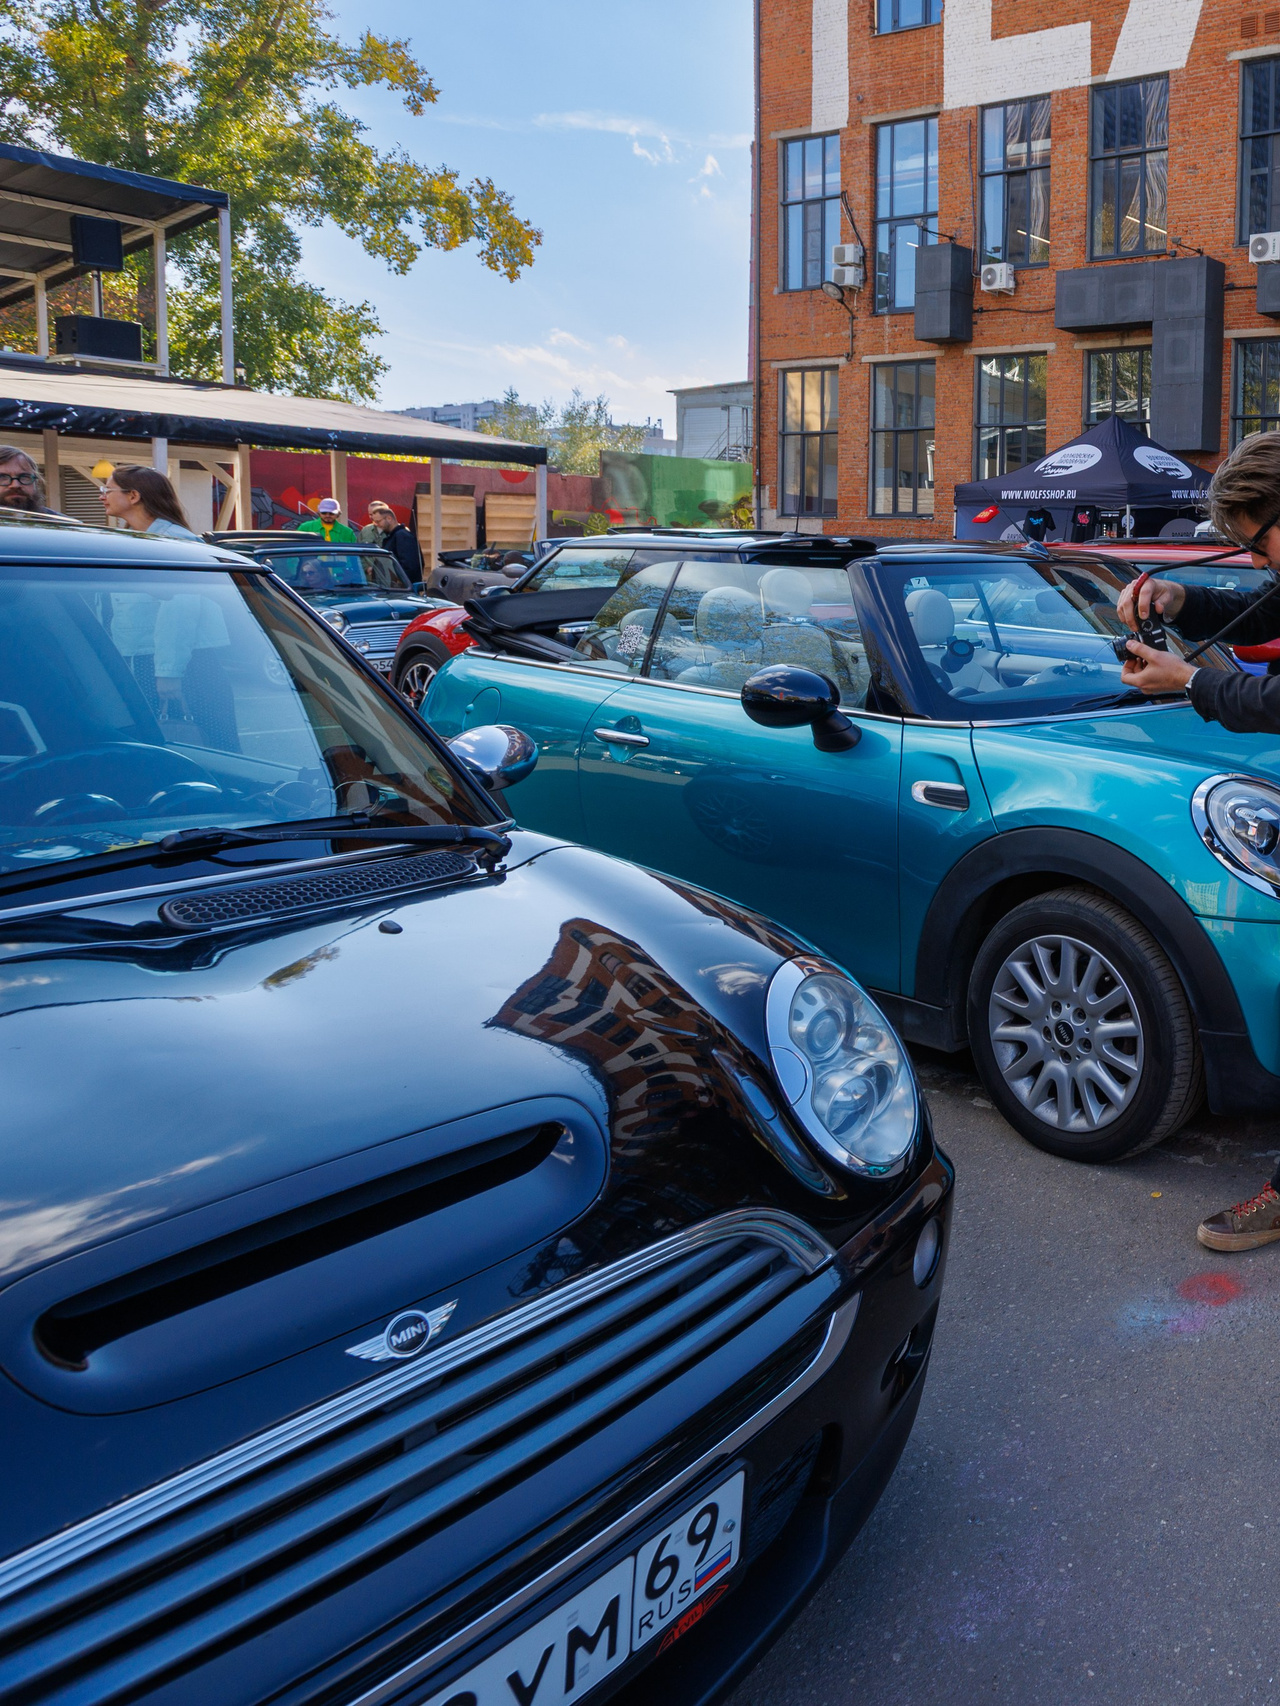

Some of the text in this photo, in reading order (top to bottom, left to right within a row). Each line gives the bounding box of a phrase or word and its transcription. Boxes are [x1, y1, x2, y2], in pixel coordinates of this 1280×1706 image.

[1001, 489, 1077, 500] WWW.WOLFSSHOP.RU
[390, 1321, 428, 1347] MINI
[645, 1501, 720, 1600] 69
[638, 1579, 692, 1640] RUS
